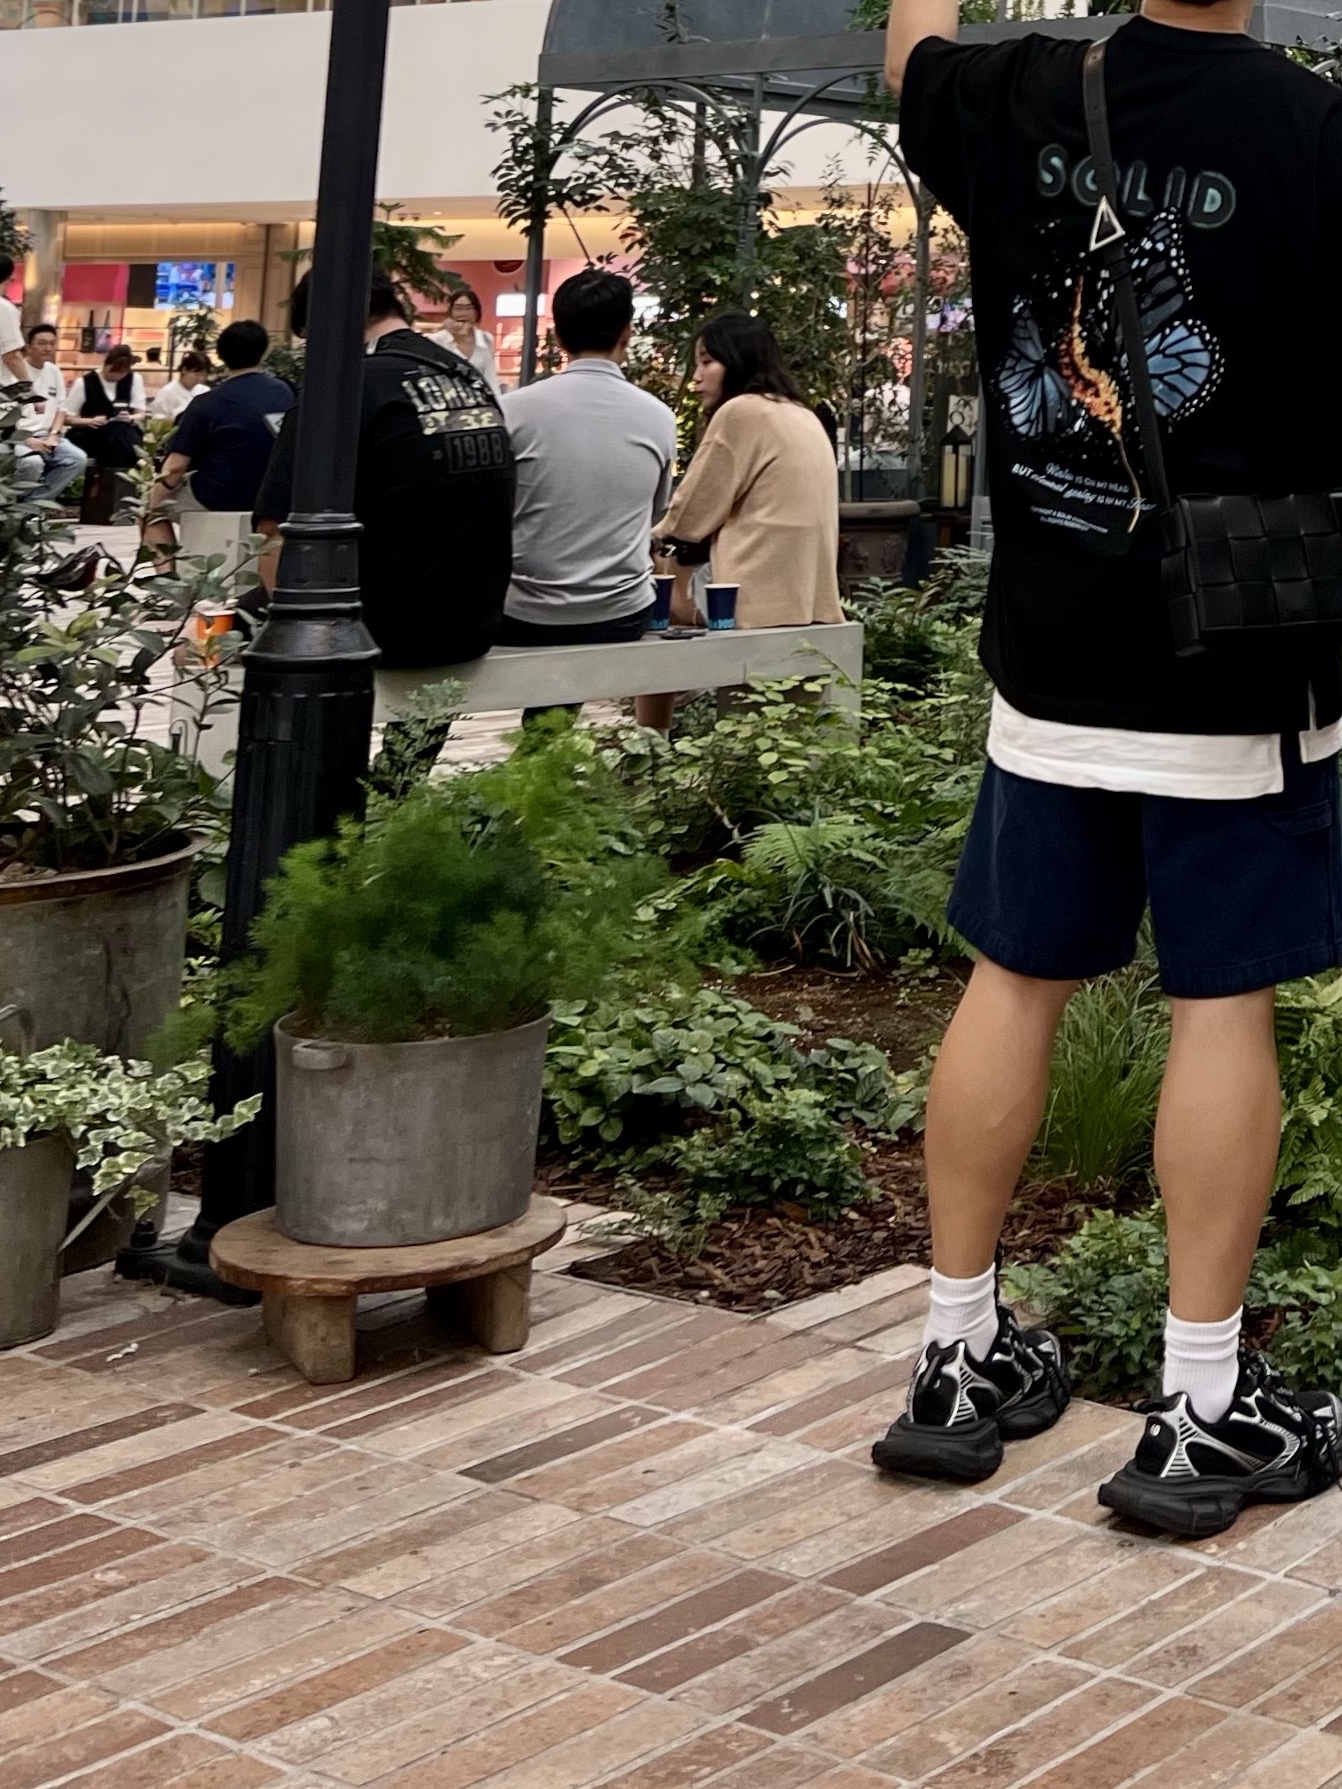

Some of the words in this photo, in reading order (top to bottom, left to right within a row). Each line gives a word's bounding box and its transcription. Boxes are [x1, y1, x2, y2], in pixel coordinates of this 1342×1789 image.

[1036, 142, 1236, 229] SOLID
[453, 432, 504, 469] 1988
[1011, 463, 1034, 477] BUT
